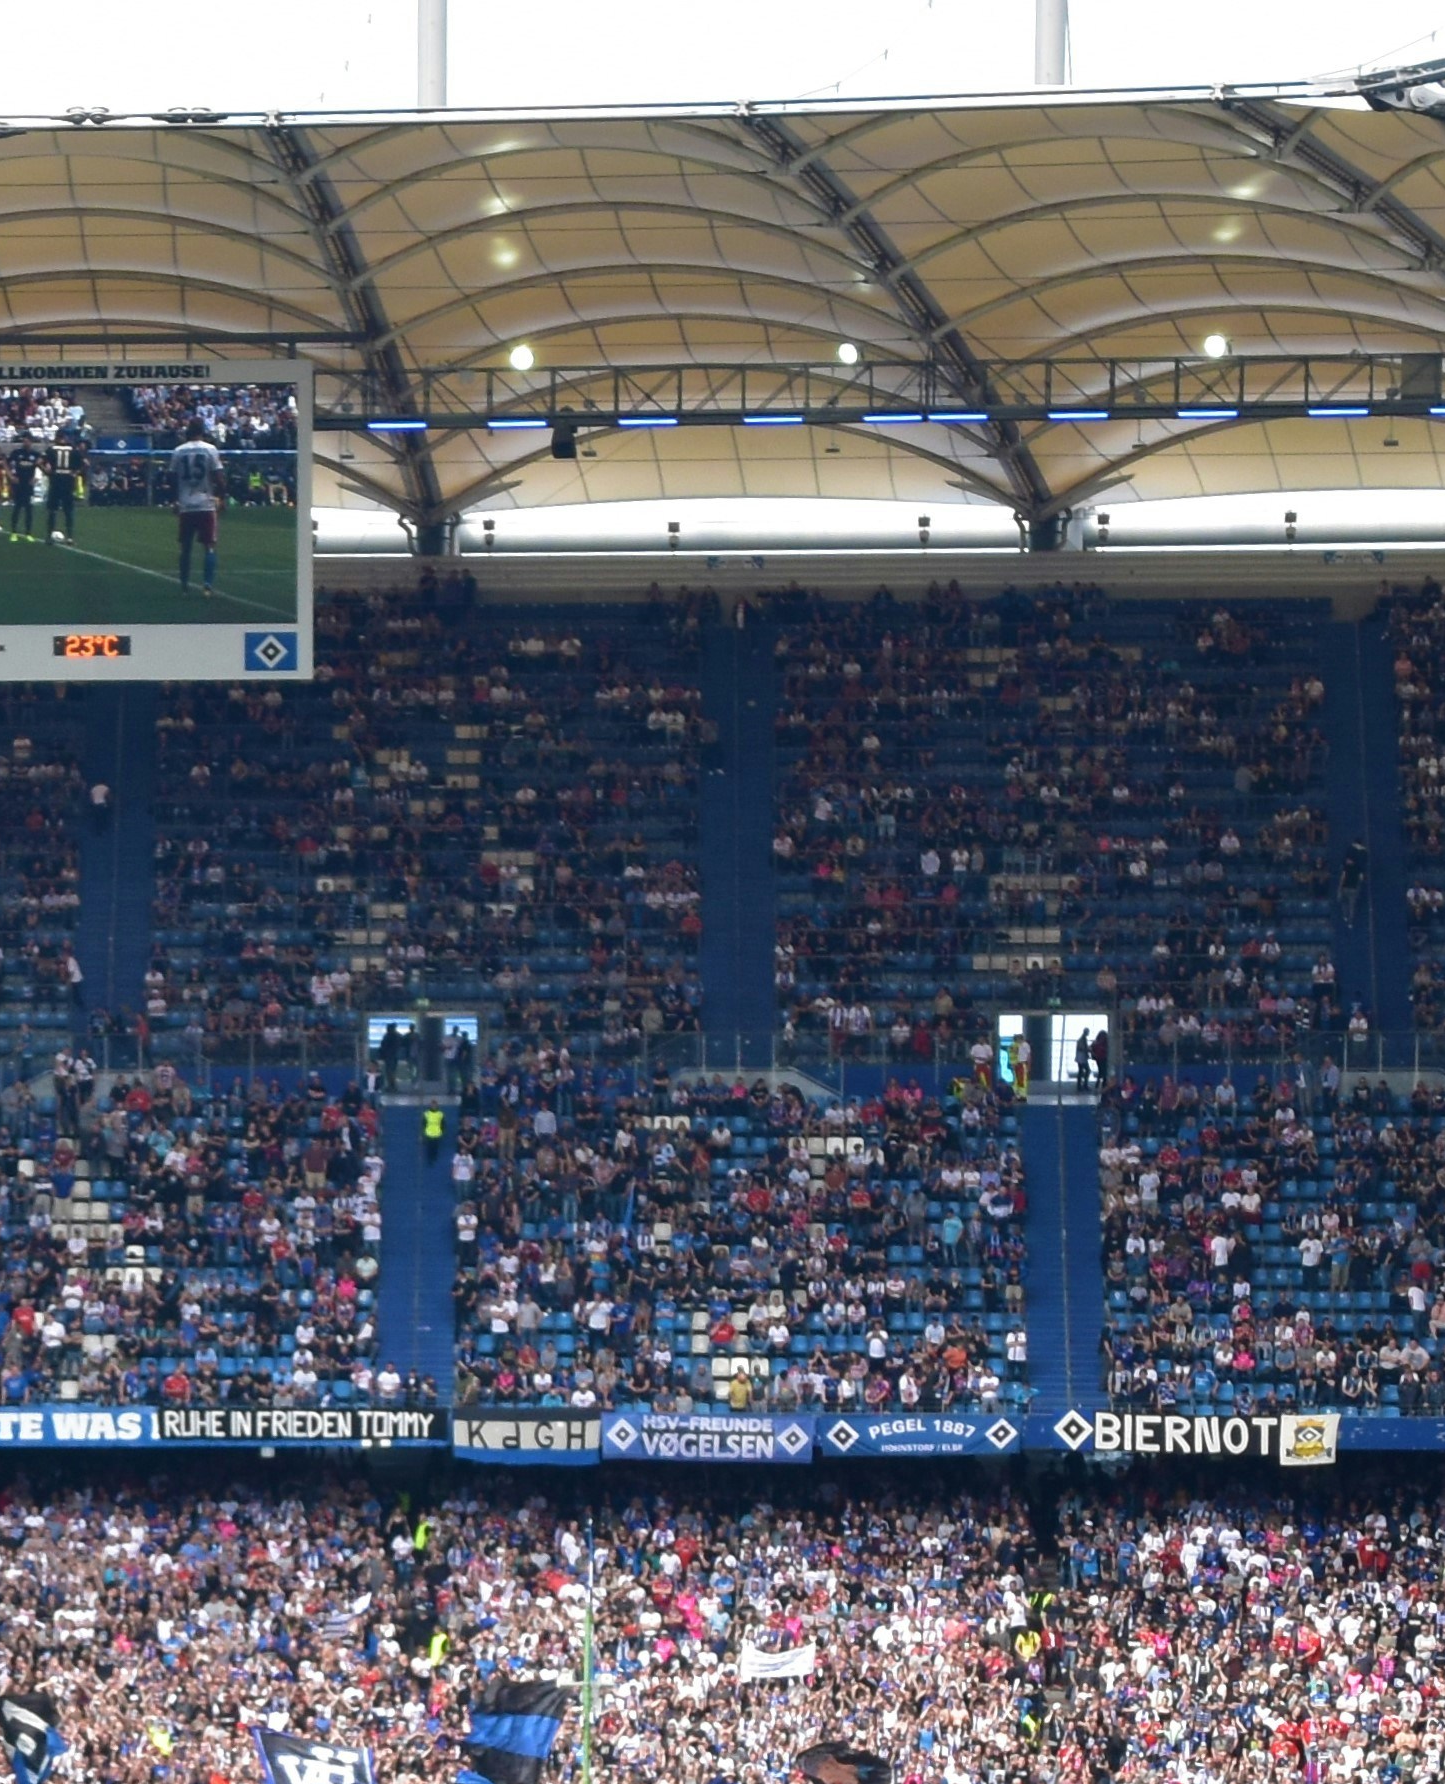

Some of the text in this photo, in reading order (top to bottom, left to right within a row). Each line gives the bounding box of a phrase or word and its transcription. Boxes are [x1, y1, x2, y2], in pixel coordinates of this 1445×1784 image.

[114, 365, 211, 379] ZUHAUSE!
[52, 1411, 142, 1440] WAS
[164, 1410, 434, 1438] RUHE IN FRIEDEN TOMMY
[868, 1417, 977, 1438] PEGEL 1887
[1093, 1410, 1278, 1455] BIERNOT
